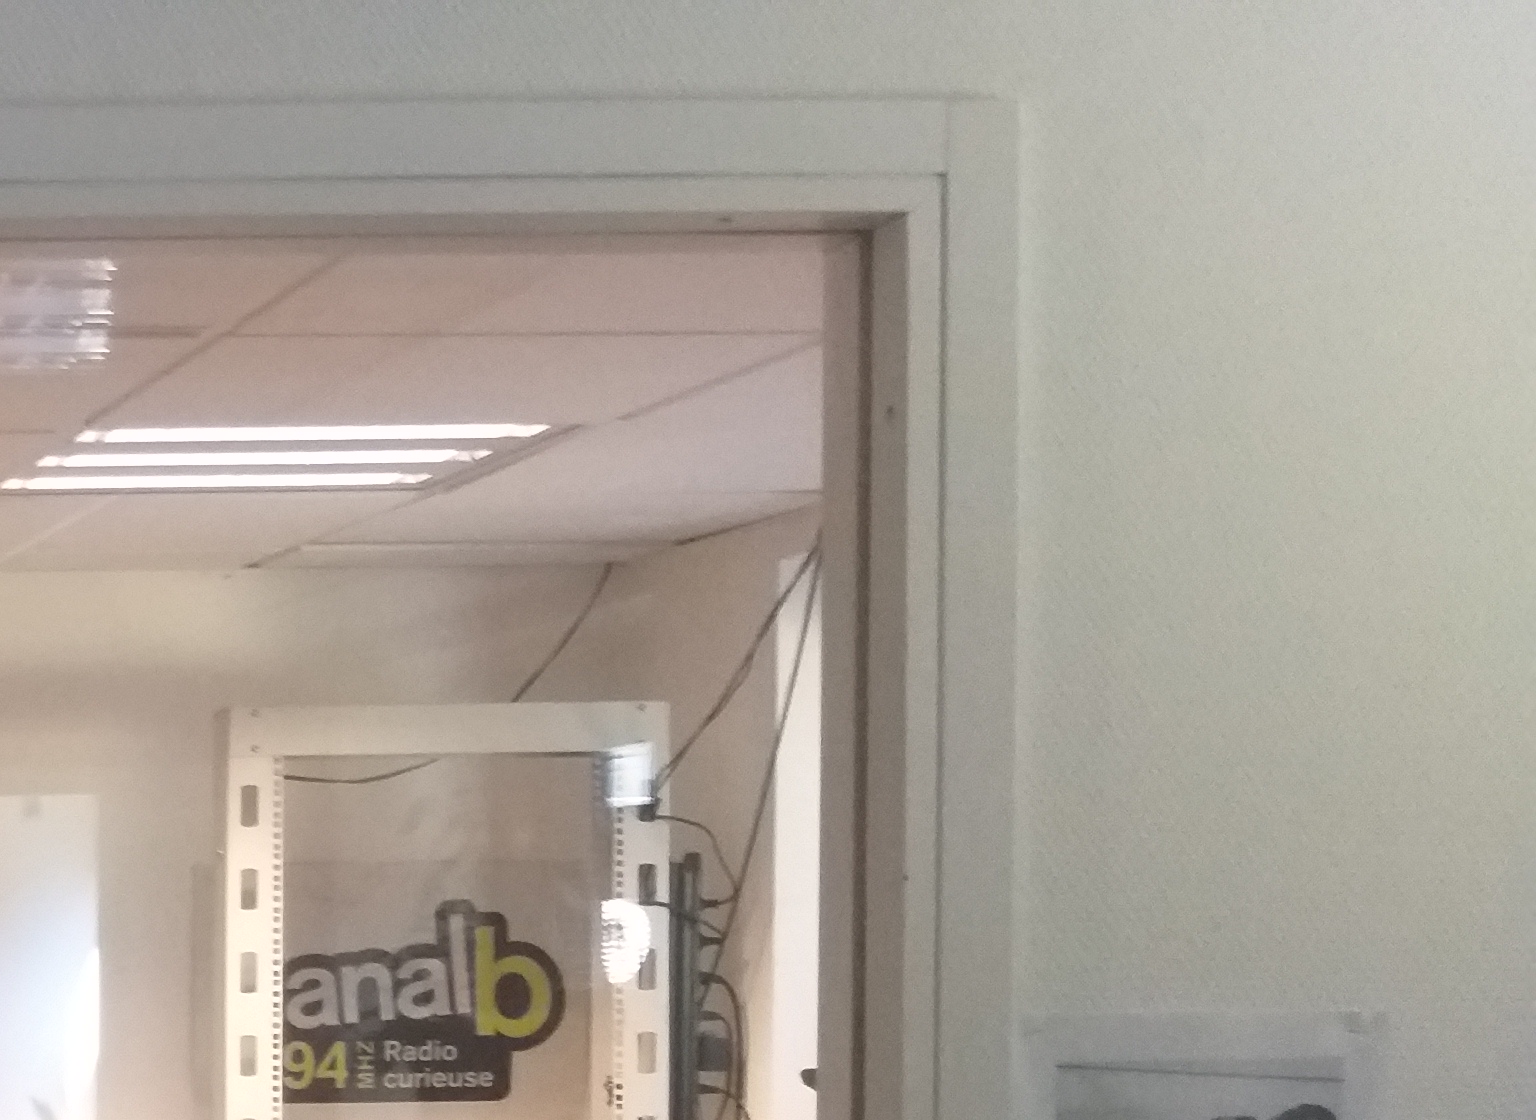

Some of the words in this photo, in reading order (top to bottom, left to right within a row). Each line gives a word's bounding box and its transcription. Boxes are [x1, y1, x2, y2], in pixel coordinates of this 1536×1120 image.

[286, 912, 554, 1038] analb
[284, 1040, 349, 1090] 94
[382, 1039, 459, 1063] Radio
[382, 1067, 495, 1089] curieuse
